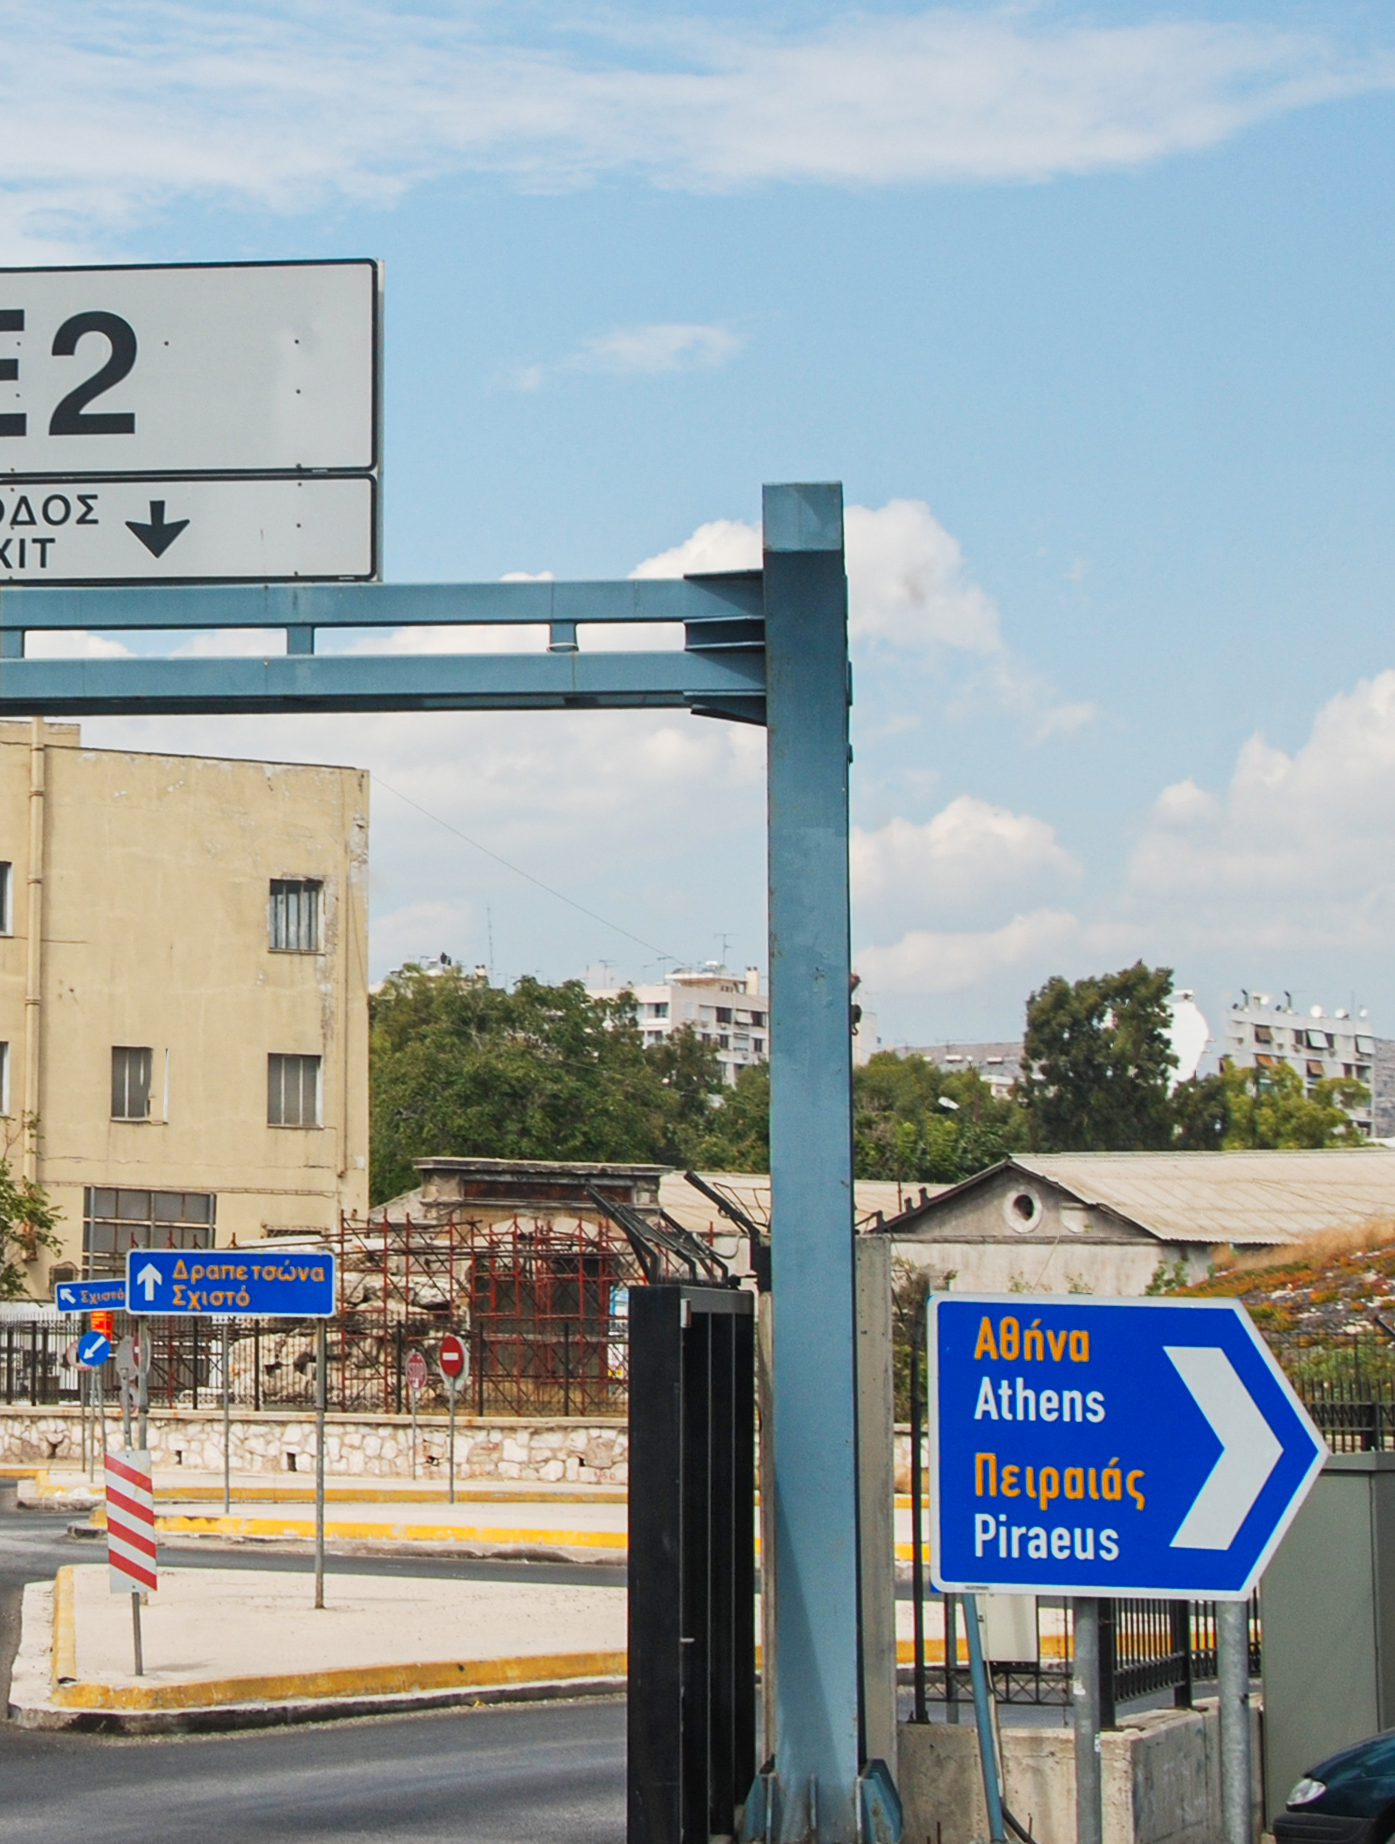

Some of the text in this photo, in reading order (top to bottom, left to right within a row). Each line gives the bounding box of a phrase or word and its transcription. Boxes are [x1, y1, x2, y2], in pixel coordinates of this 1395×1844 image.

[172, 1284, 251, 1311] Σχιστό
[973, 1316, 1091, 1363] Αθήνα
[973, 1376, 1106, 1423] Athens
[974, 1452, 1146, 1511] Πειραιάς
[974, 1513, 1120, 1561] Piraeus
